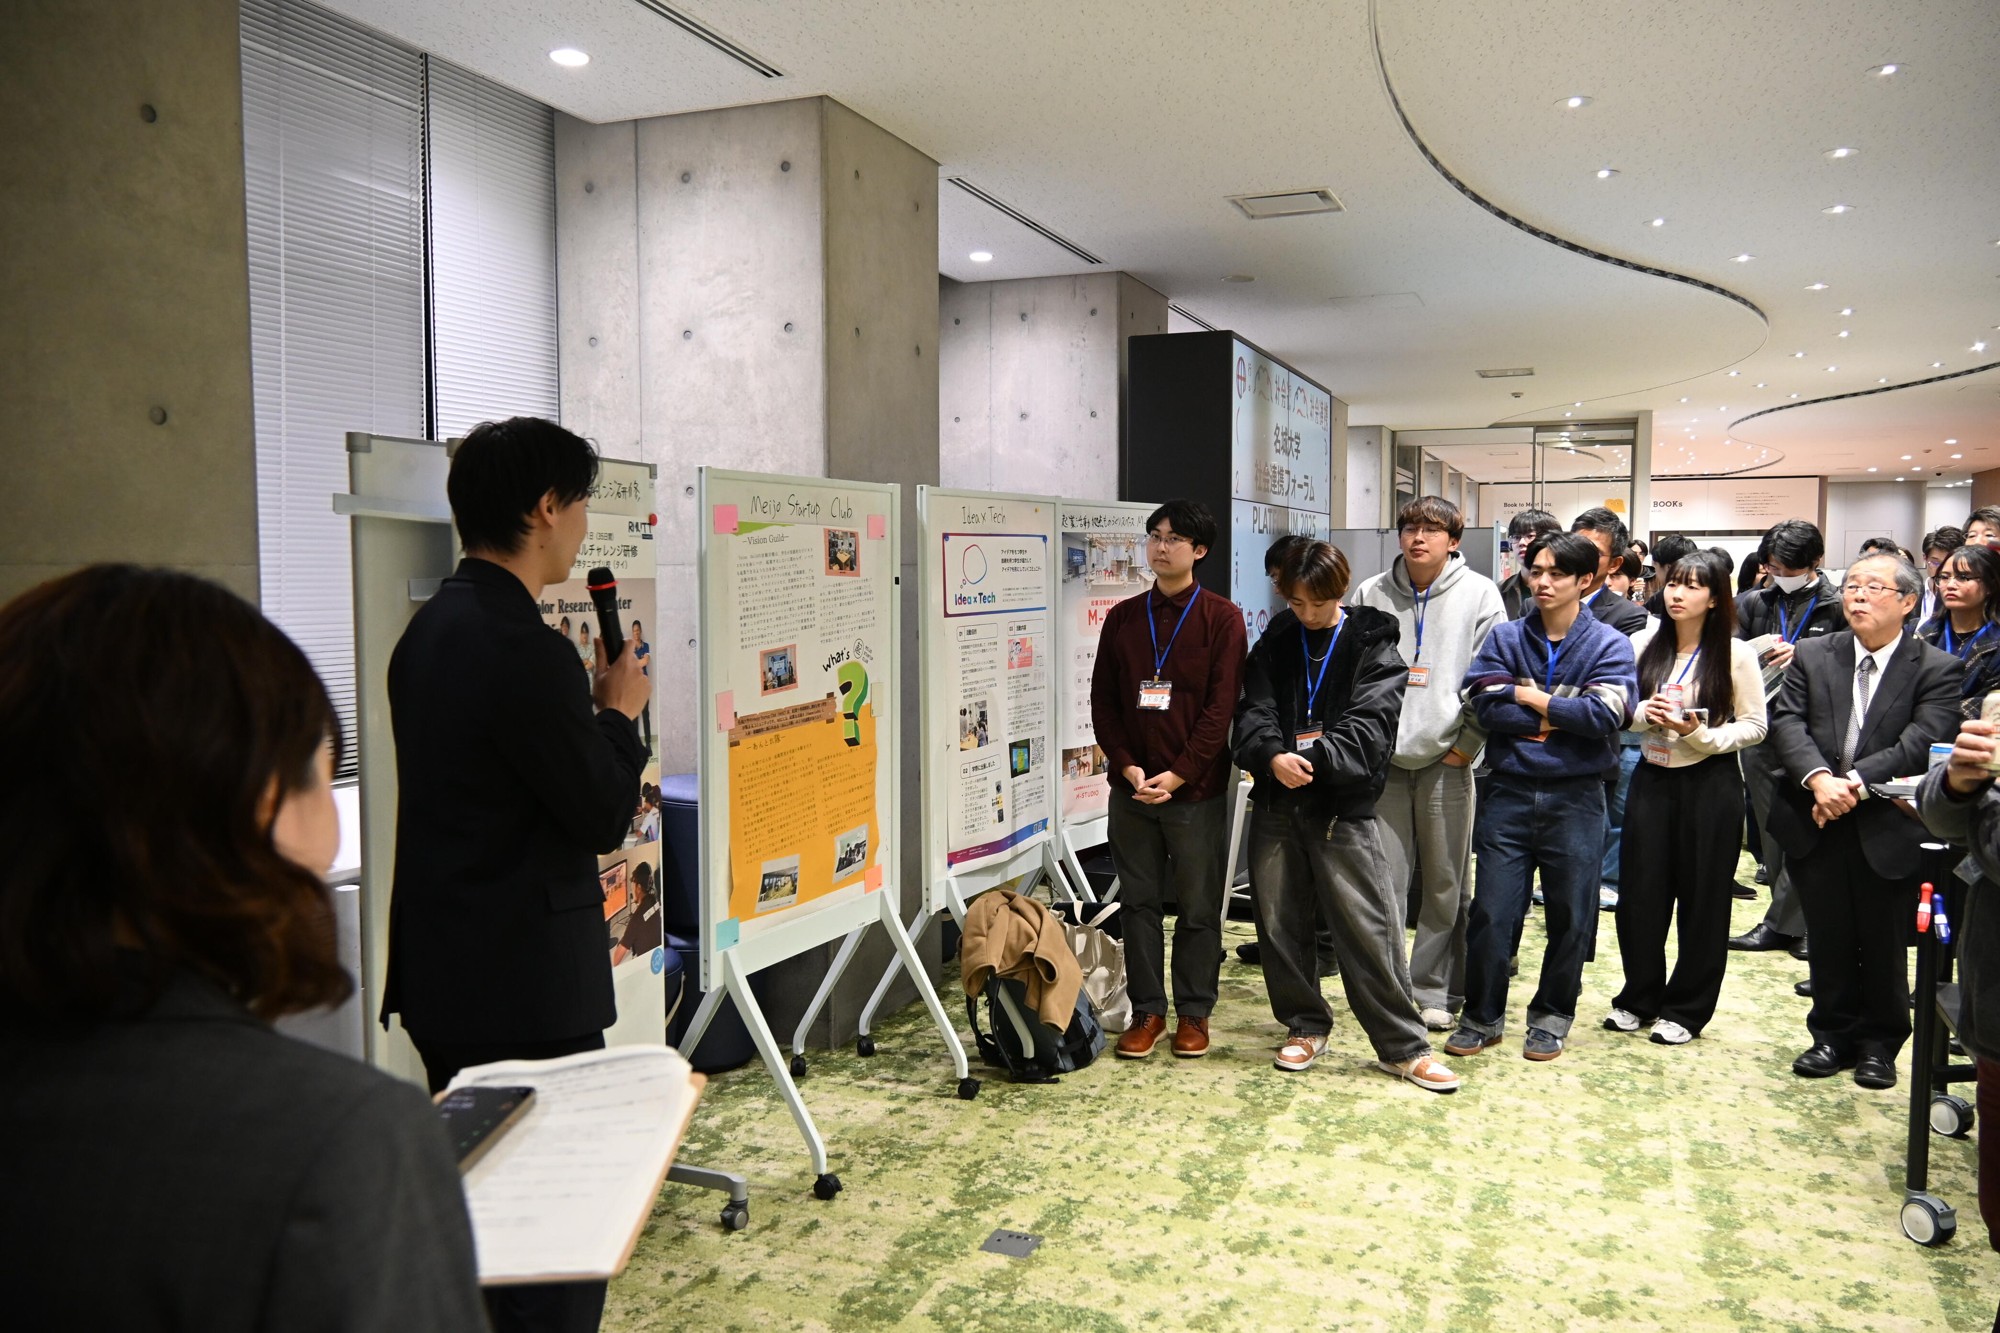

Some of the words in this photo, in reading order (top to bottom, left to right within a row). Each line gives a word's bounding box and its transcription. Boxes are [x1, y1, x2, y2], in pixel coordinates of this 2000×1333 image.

[1273, 423, 1301, 459] 名城大学
[1255, 459, 1316, 502] 社会連携フォーラム
[751, 495, 782, 519] Meijo
[788, 493, 821, 525] Startup
[830, 496, 853, 519] Club
[987, 505, 1006, 524] Tech
[1653, 500, 1683, 508] BOOKs
[1253, 506, 1299, 536] PLATFUM
[1300, 513, 1316, 538] 2025
[579, 543, 638, 558] ルチャレンジ研修
[954, 593, 972, 606] Idea
[978, 592, 996, 605] Tech
